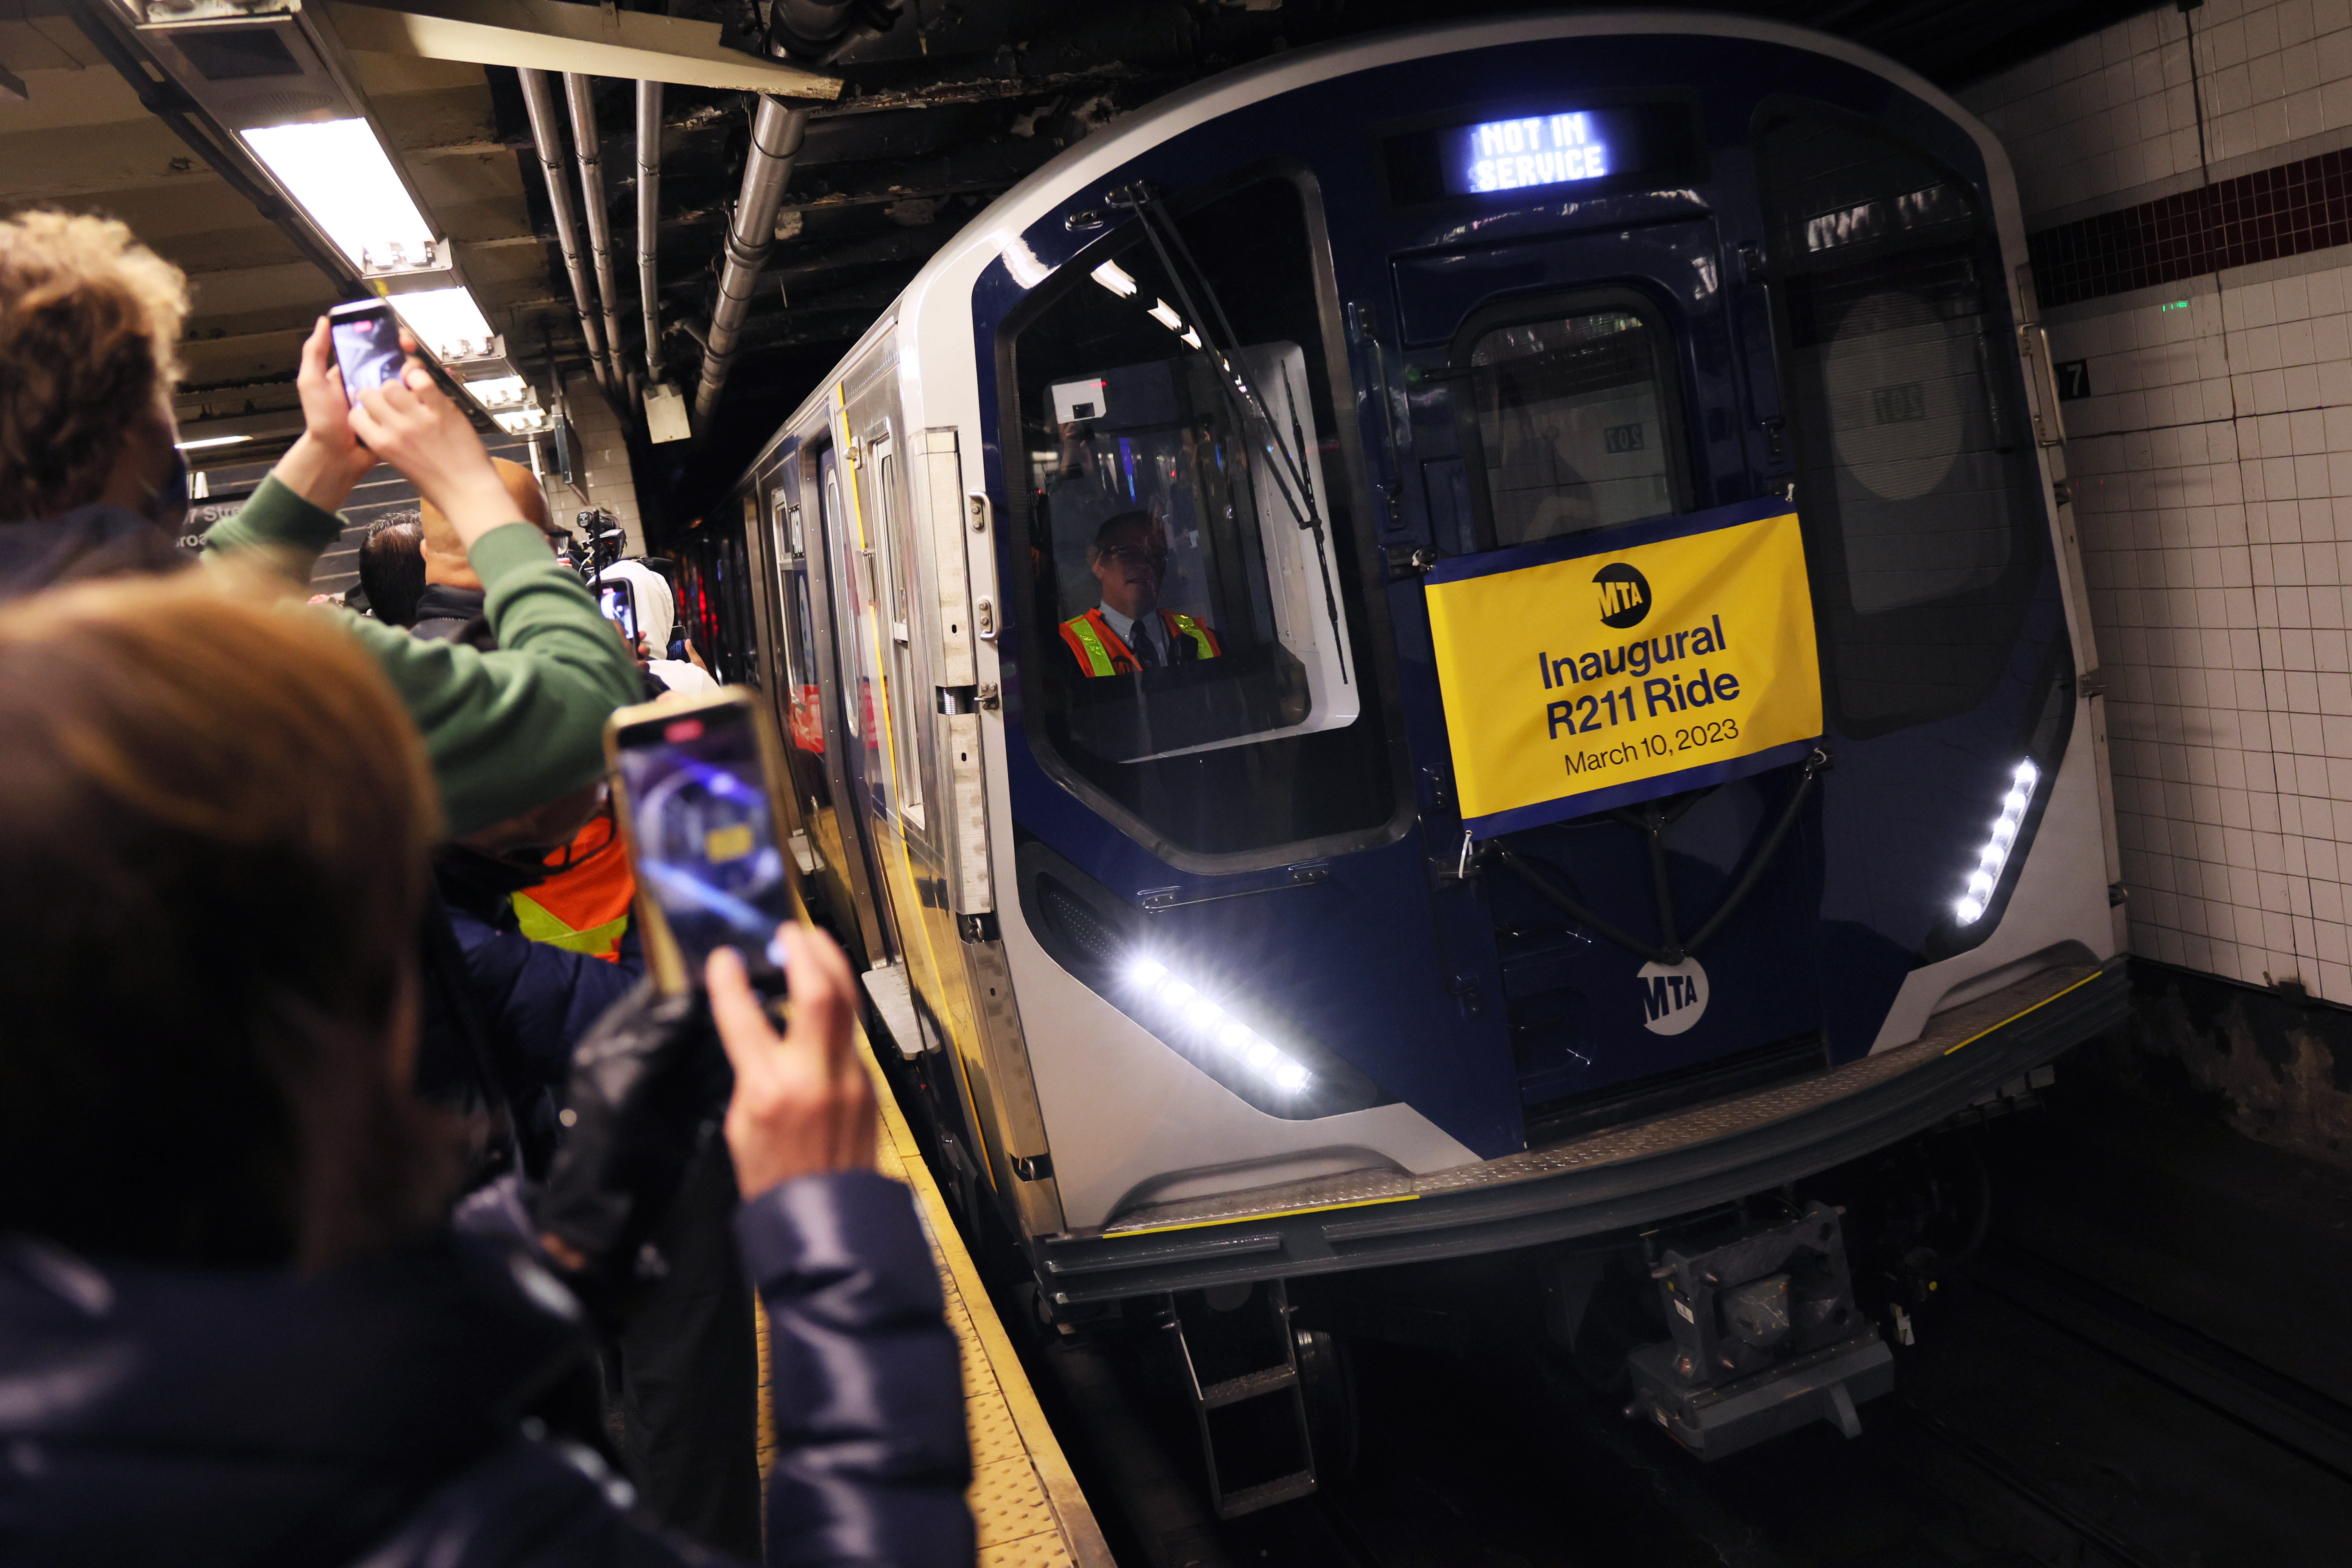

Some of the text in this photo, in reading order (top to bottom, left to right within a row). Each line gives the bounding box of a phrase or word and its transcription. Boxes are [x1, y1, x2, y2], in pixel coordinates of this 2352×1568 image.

[1480, 114, 1585, 156] NOT IN
[1476, 146, 1605, 191] SERVICE
[1592, 581, 1643, 620] MTA
[1539, 614, 1727, 690] Inaugural
[1546, 669, 1741, 740] R211 Ride
[1564, 717, 1740, 776] March 10, 2023
[1637, 975, 1698, 1026] MTA
